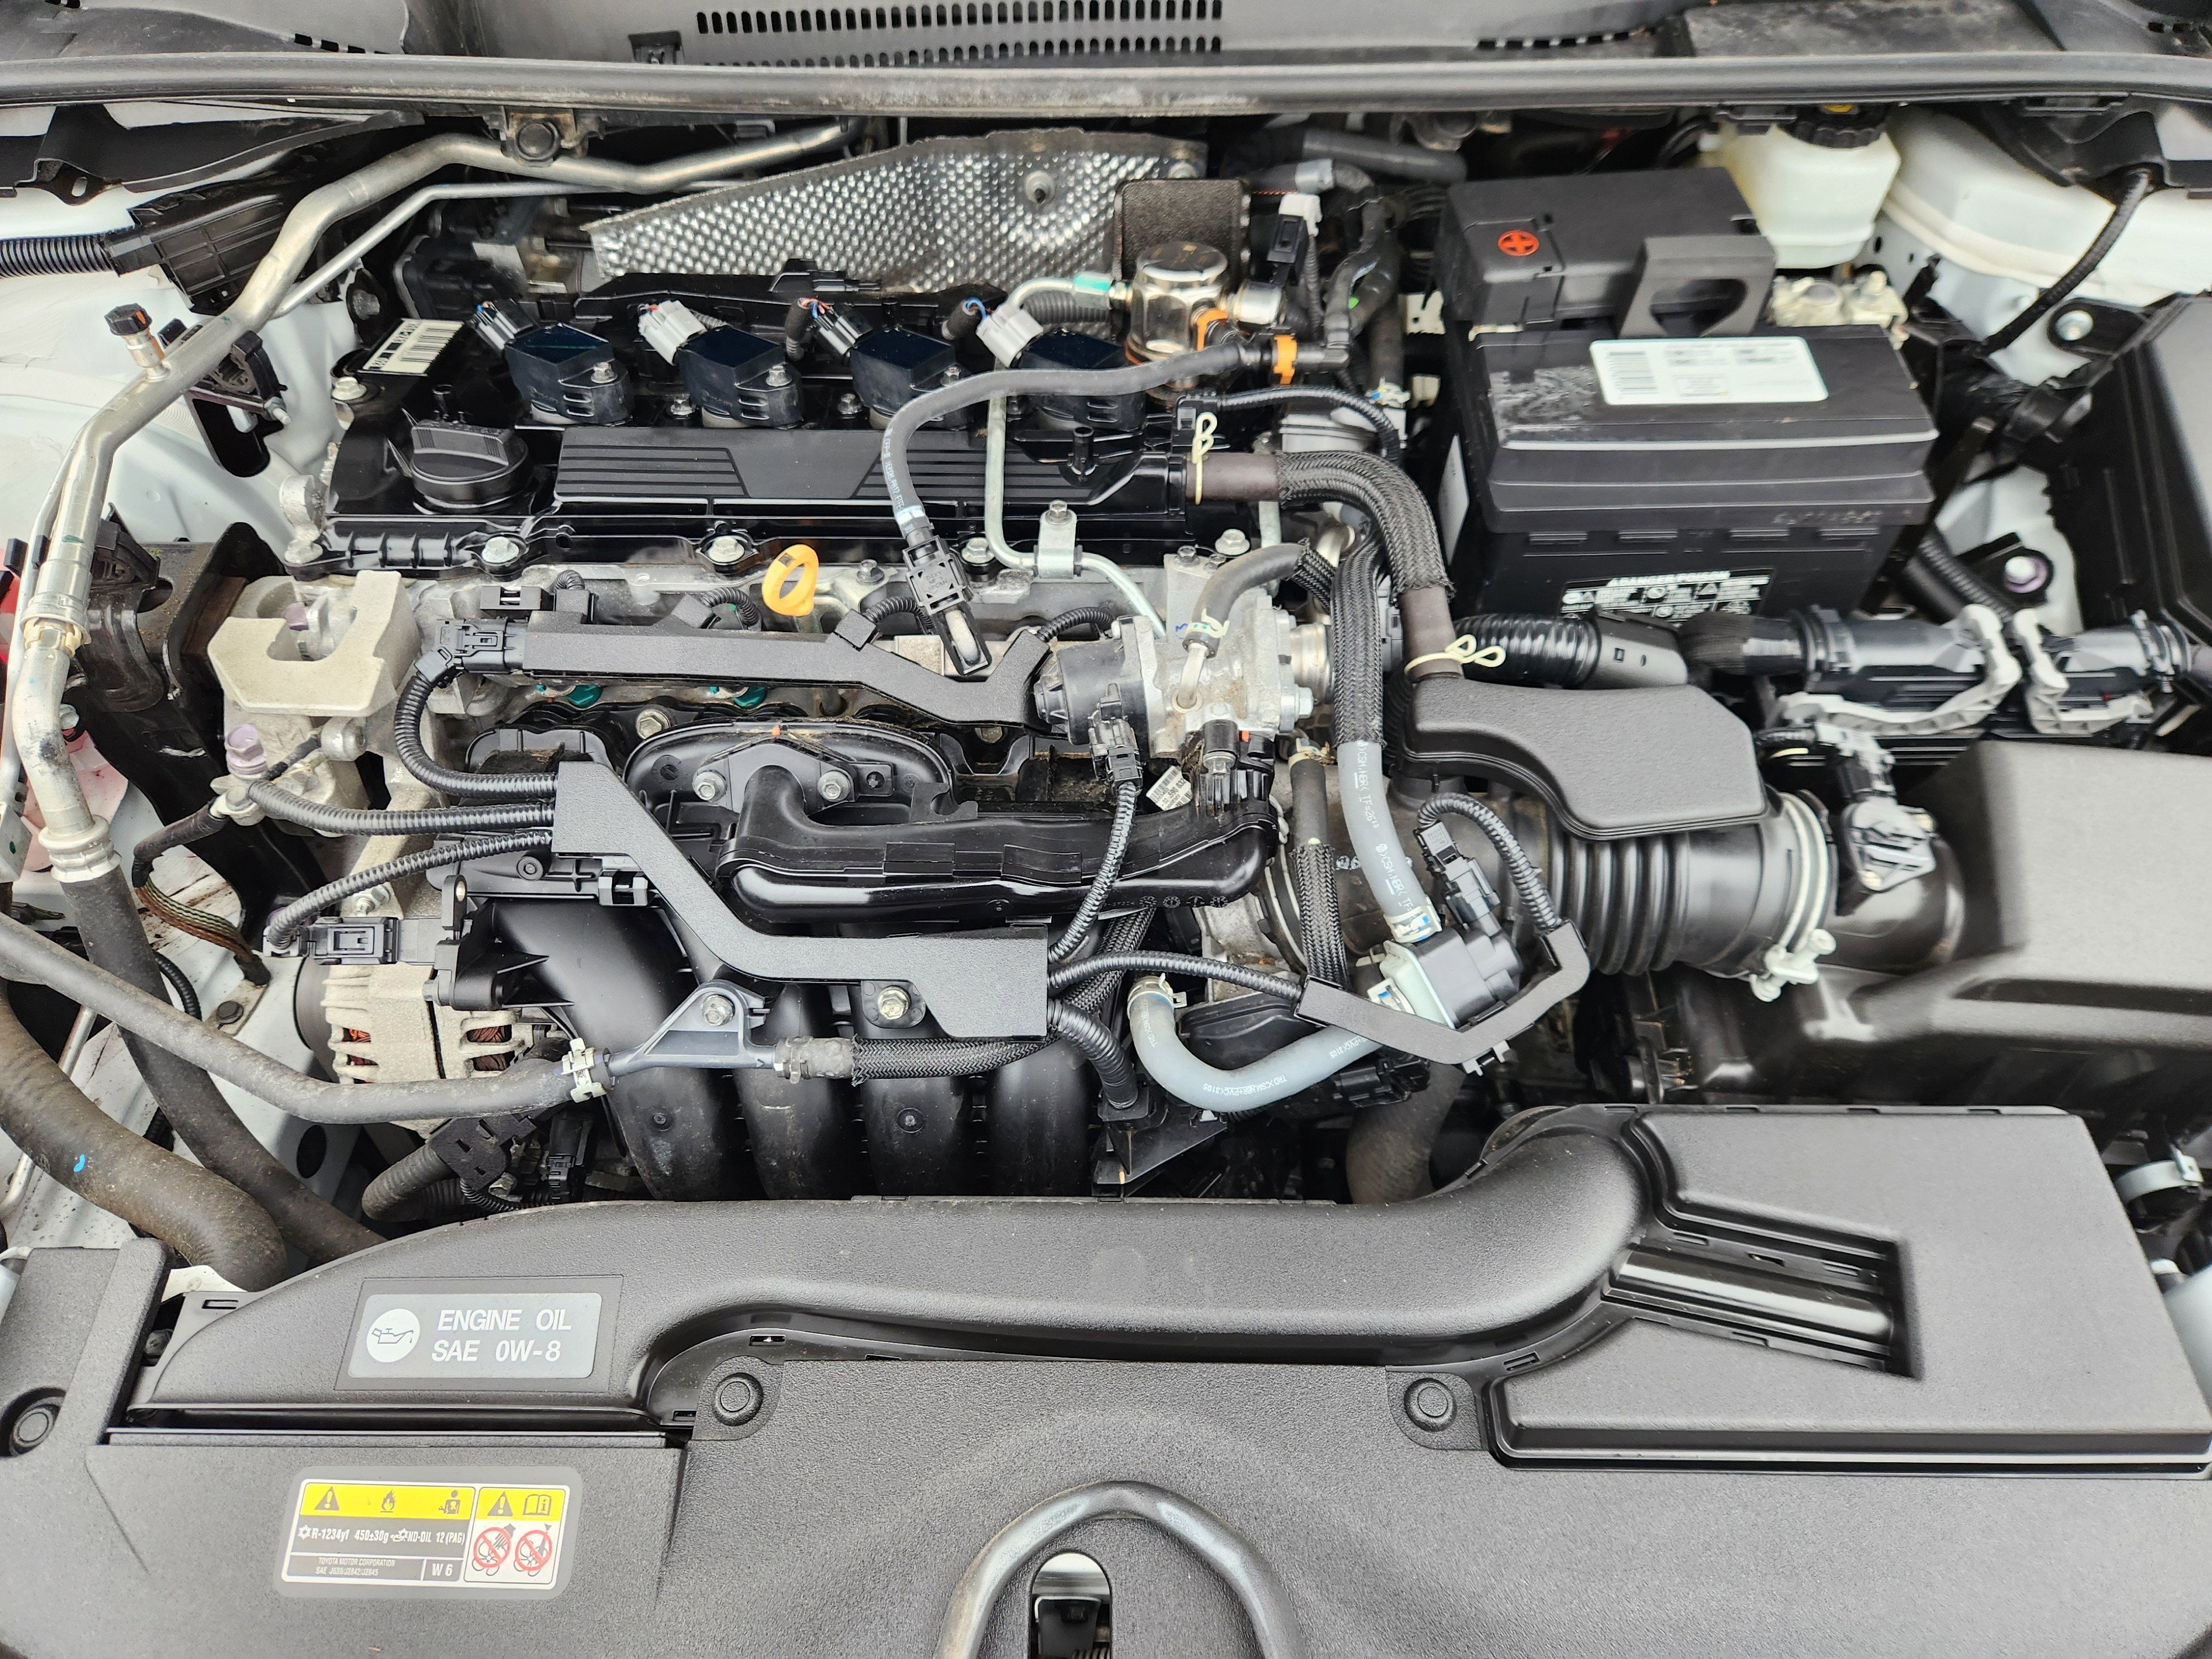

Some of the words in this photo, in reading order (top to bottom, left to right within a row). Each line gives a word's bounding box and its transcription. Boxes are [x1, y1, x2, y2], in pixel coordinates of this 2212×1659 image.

[437, 1309, 523, 1332] ENGINE
[536, 1308, 572, 1331] OIL
[431, 1339, 481, 1361] SAE
[495, 1339, 561, 1361] 0W-8
[354, 1529, 389, 1544] 450±30g
[436, 1532, 445, 1543] 12
[445, 1531, 466, 1546] (PAG)
[319, 1557, 339, 1566] TOYOTA
[339, 1558, 358, 1566] MOTOR
[358, 1558, 396, 1567] CORPORATION
[315, 1567, 327, 1575] SAE
[431, 1563, 444, 1576] W
[445, 1563, 453, 1577] 6
